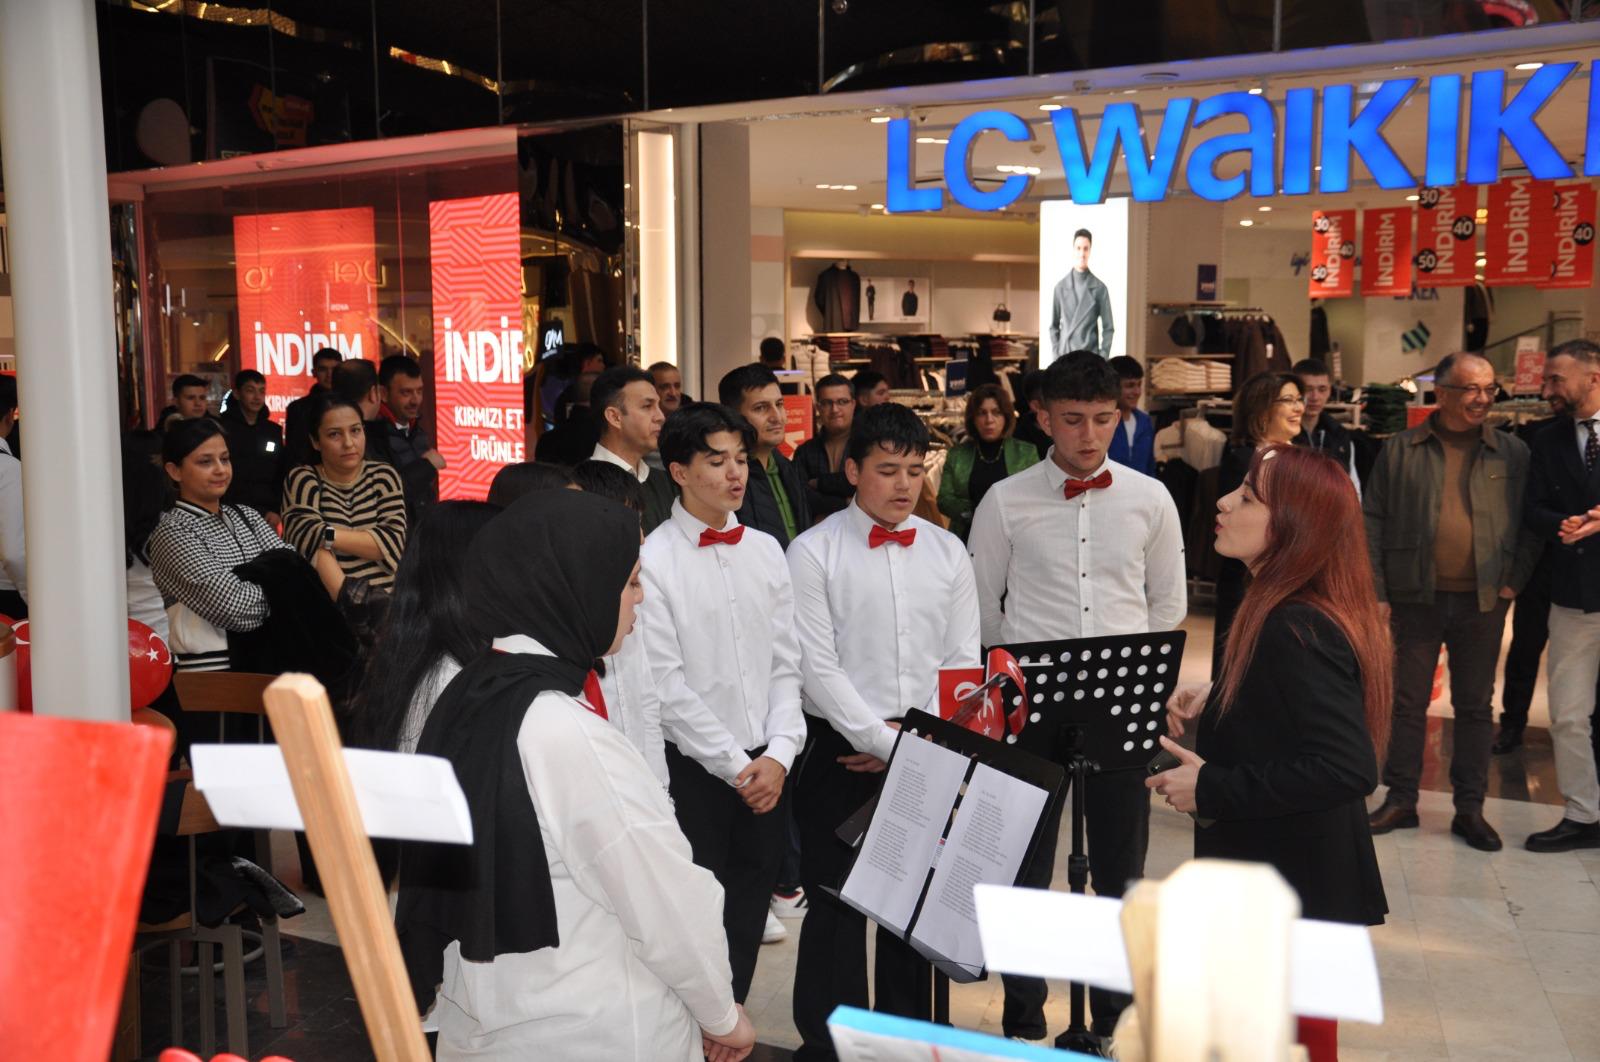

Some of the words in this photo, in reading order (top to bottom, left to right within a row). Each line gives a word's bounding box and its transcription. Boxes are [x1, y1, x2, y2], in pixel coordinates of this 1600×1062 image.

[887, 109, 1031, 213] LC
[1421, 190, 1438, 205] 30
[1314, 217, 1329, 230] 30
[1454, 220, 1473, 235] 40
[1502, 178, 1531, 273] İNDİRİM
[1574, 226, 1593, 241] 40
[1373, 212, 1395, 287] İNDİRİM
[1418, 254, 1436, 269] 50
[1311, 267, 1328, 281] 50
[264, 393, 302, 413] KIRM
[454, 406, 502, 430] KIRMIZI
